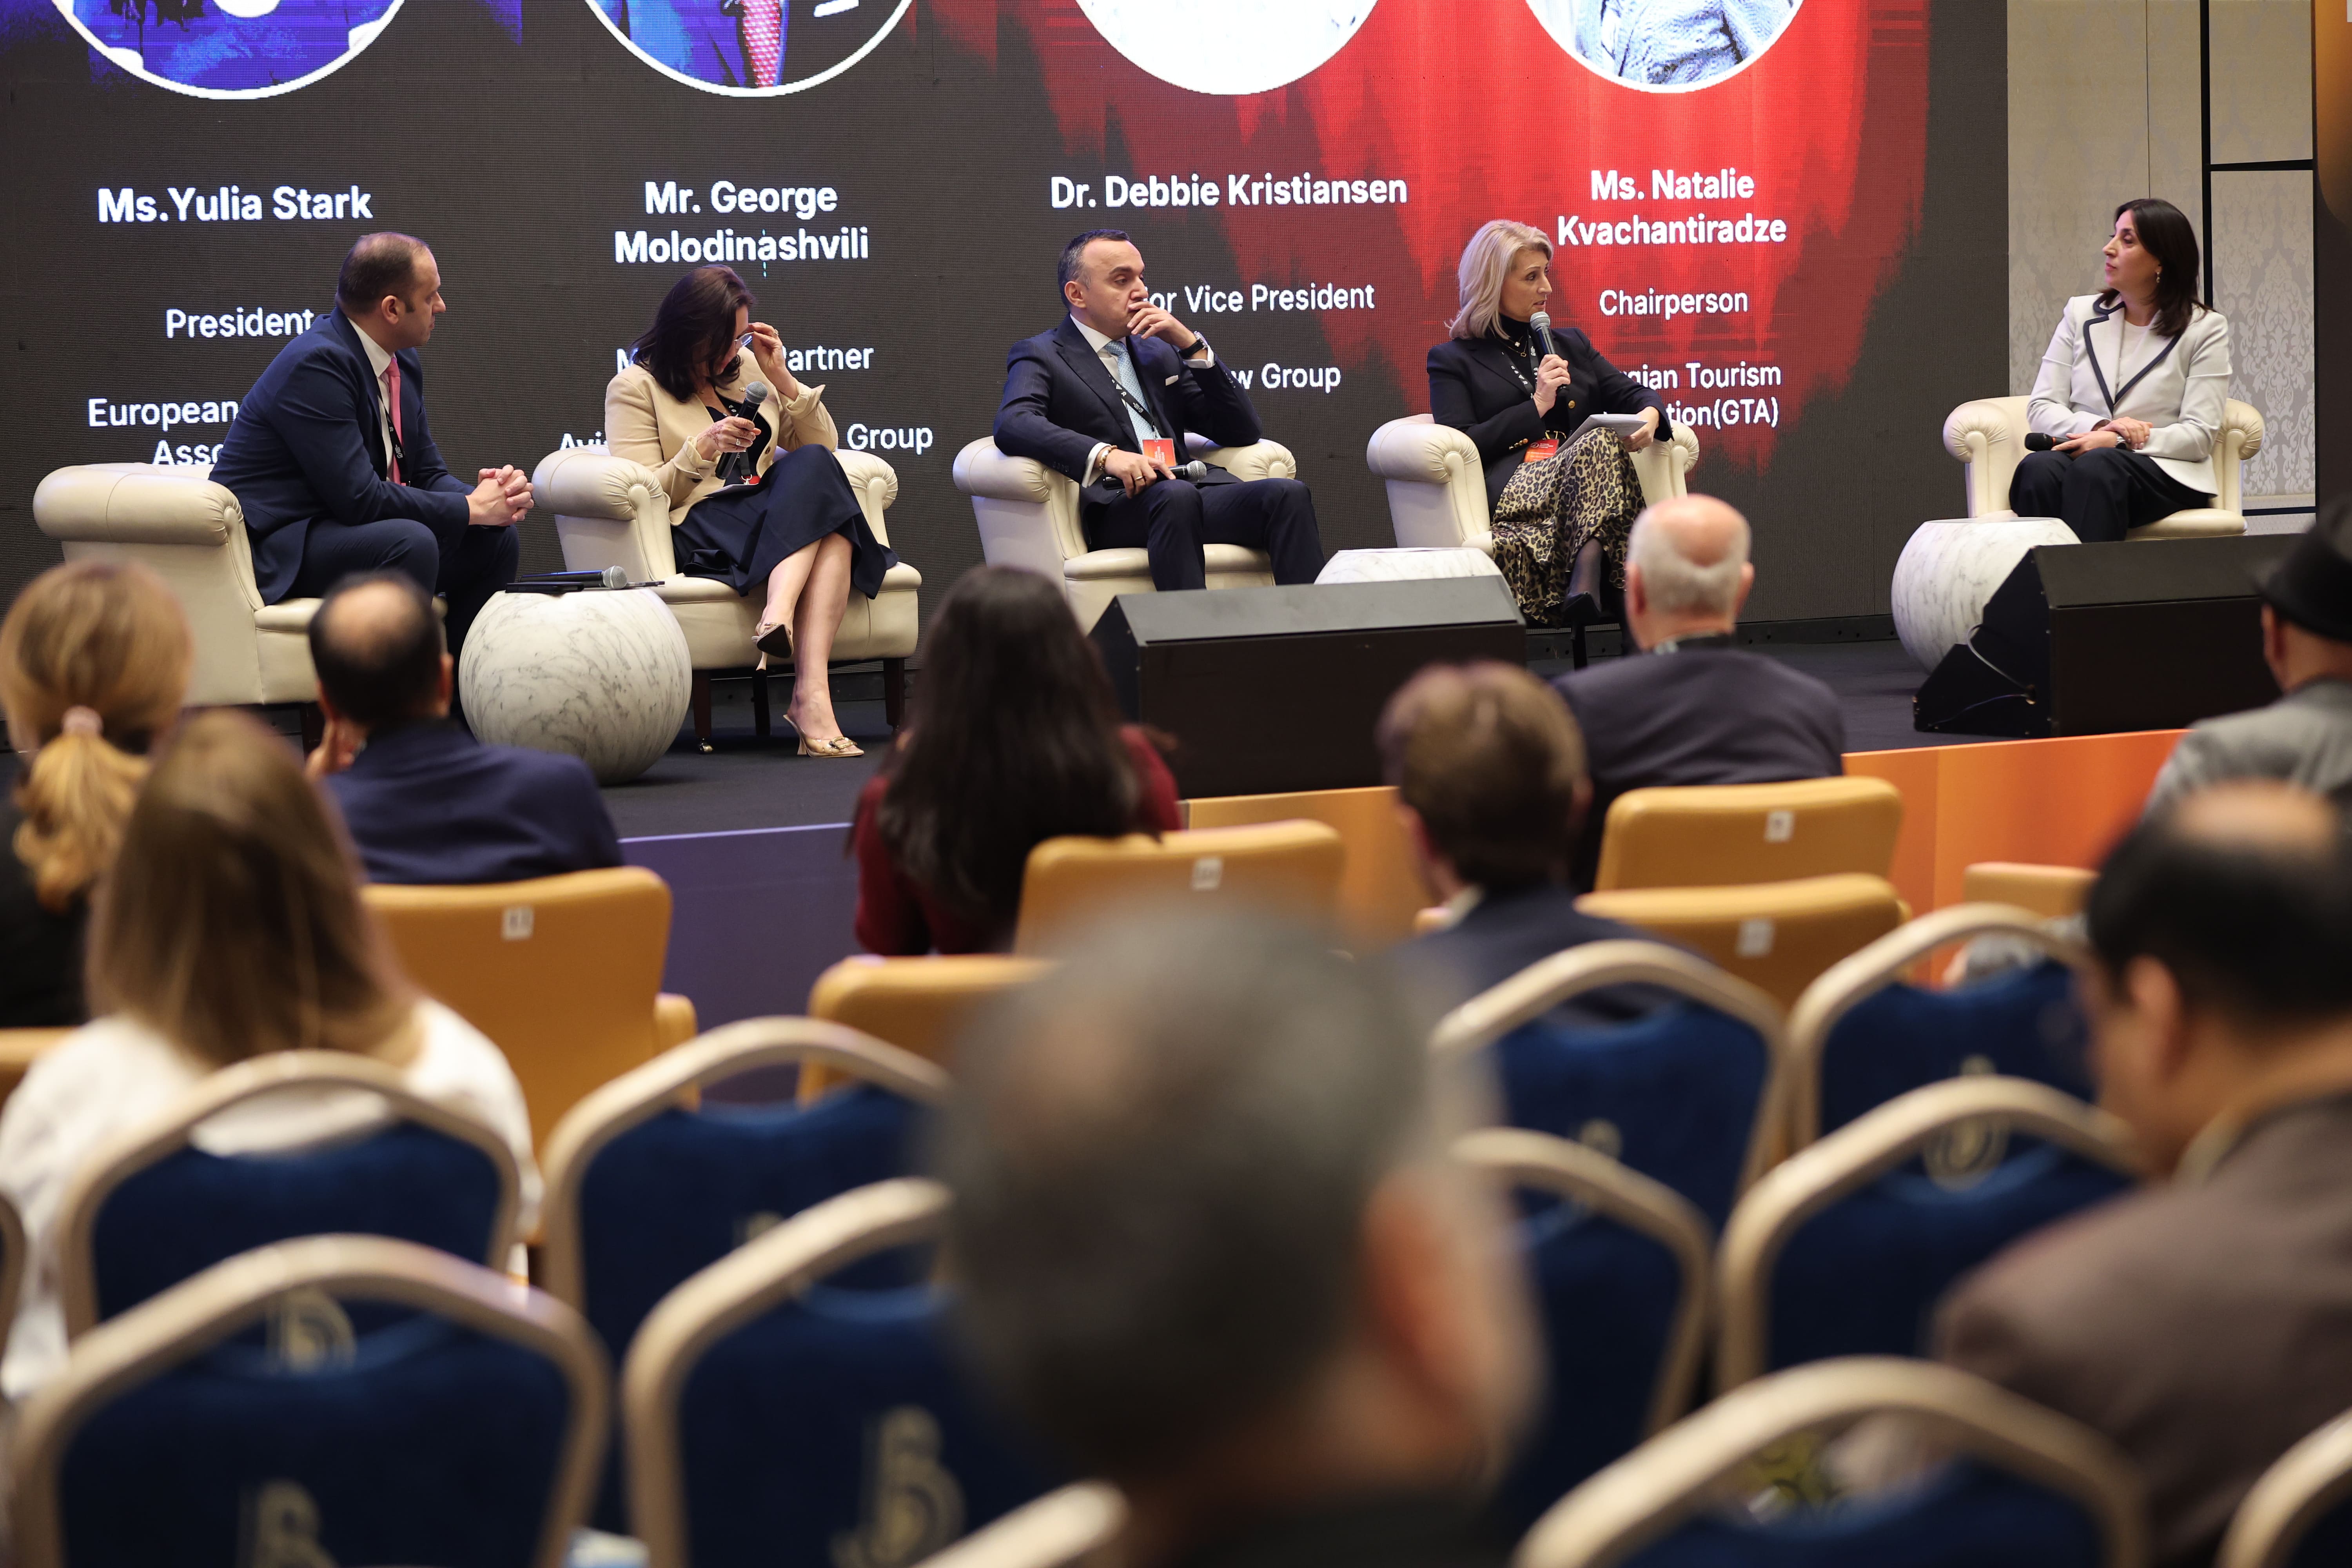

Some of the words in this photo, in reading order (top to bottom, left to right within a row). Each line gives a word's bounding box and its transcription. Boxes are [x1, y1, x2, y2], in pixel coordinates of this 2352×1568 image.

[645, 181, 701, 214] Mr.
[711, 180, 838, 220] George
[1051, 176, 1096, 208] Dr.
[1105, 173, 1220, 207] Debbie
[1228, 172, 1407, 206] Kristiansen
[1590, 169, 1645, 201] Ms.
[1651, 167, 1755, 200] Natalie
[273, 185, 373, 220] Stark
[615, 227, 868, 263] Molodinashvili
[1558, 213, 1787, 246] Kvachantiradze
[1184, 285, 1243, 313] Vice
[1252, 282, 1375, 311] President
[1599, 287, 1748, 319] Chairperson
[167, 307, 314, 338] President
[1261, 363, 1341, 394] Group
[1622, 364, 1678, 389] gian
[1685, 361, 1781, 389] Tourism
[89, 398, 239, 432] European
[1666, 397, 1779, 430] tion(GTA)
[847, 423, 933, 454] Group
